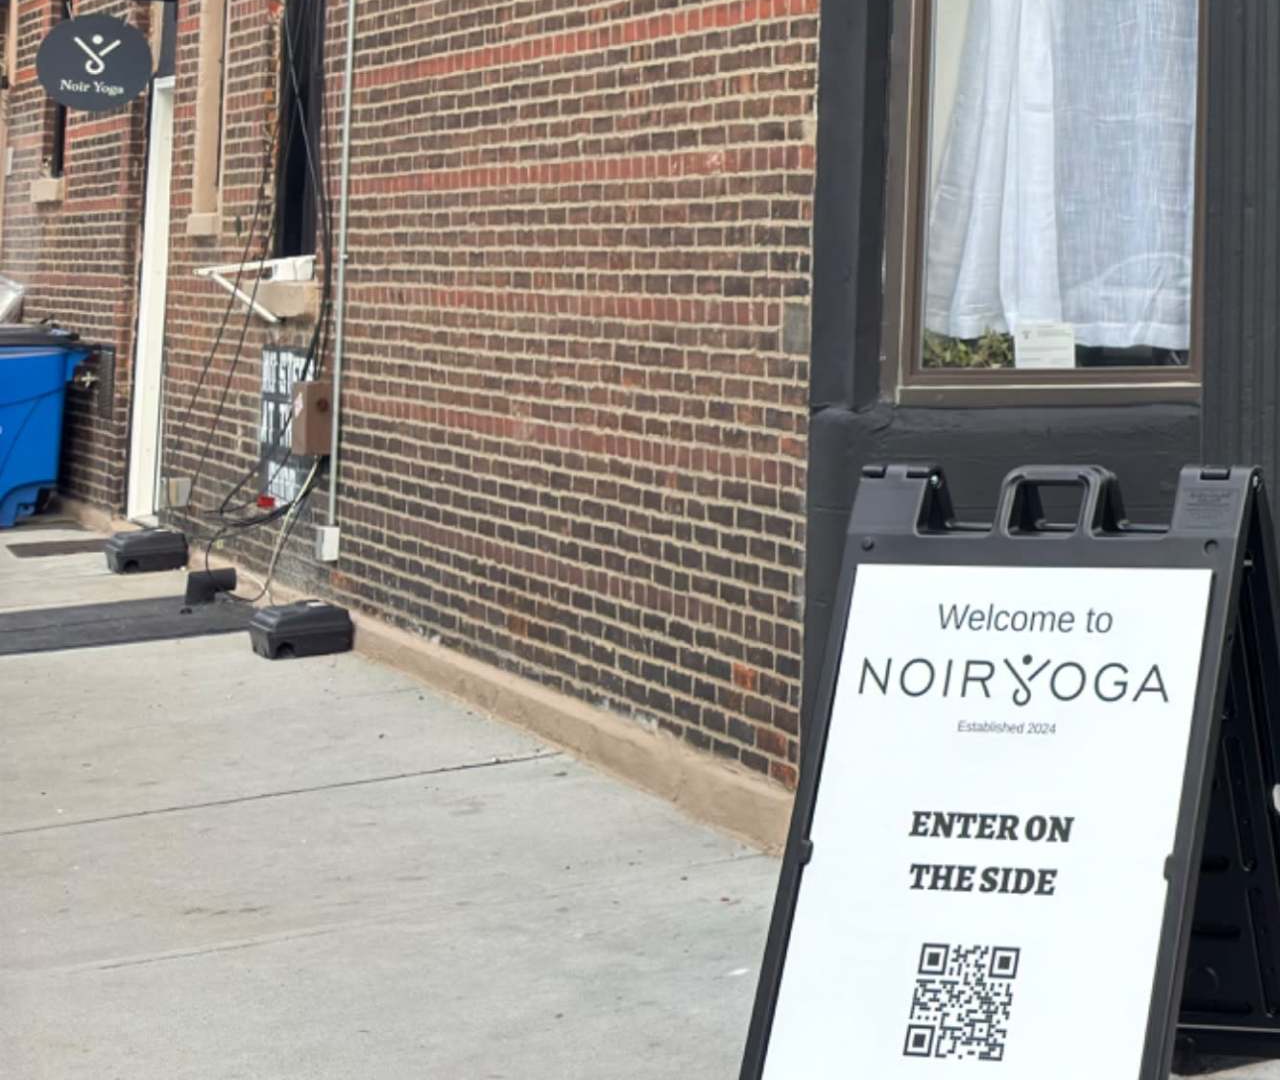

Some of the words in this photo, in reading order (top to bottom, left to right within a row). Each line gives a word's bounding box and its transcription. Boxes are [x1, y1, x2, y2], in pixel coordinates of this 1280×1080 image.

[59, 79, 91, 93] Noir
[93, 81, 125, 96] Yoga
[938, 603, 1075, 633] Welcome
[1086, 608, 1114, 634] to
[858, 654, 1169, 707] NOIRYOGA
[957, 719, 1025, 735] Established
[1027, 721, 1057, 735] 2024
[908, 810, 1020, 841] ENTER
[1024, 815, 1076, 843] ON
[909, 863, 977, 893] THE
[979, 866, 1058, 896] SIDE
